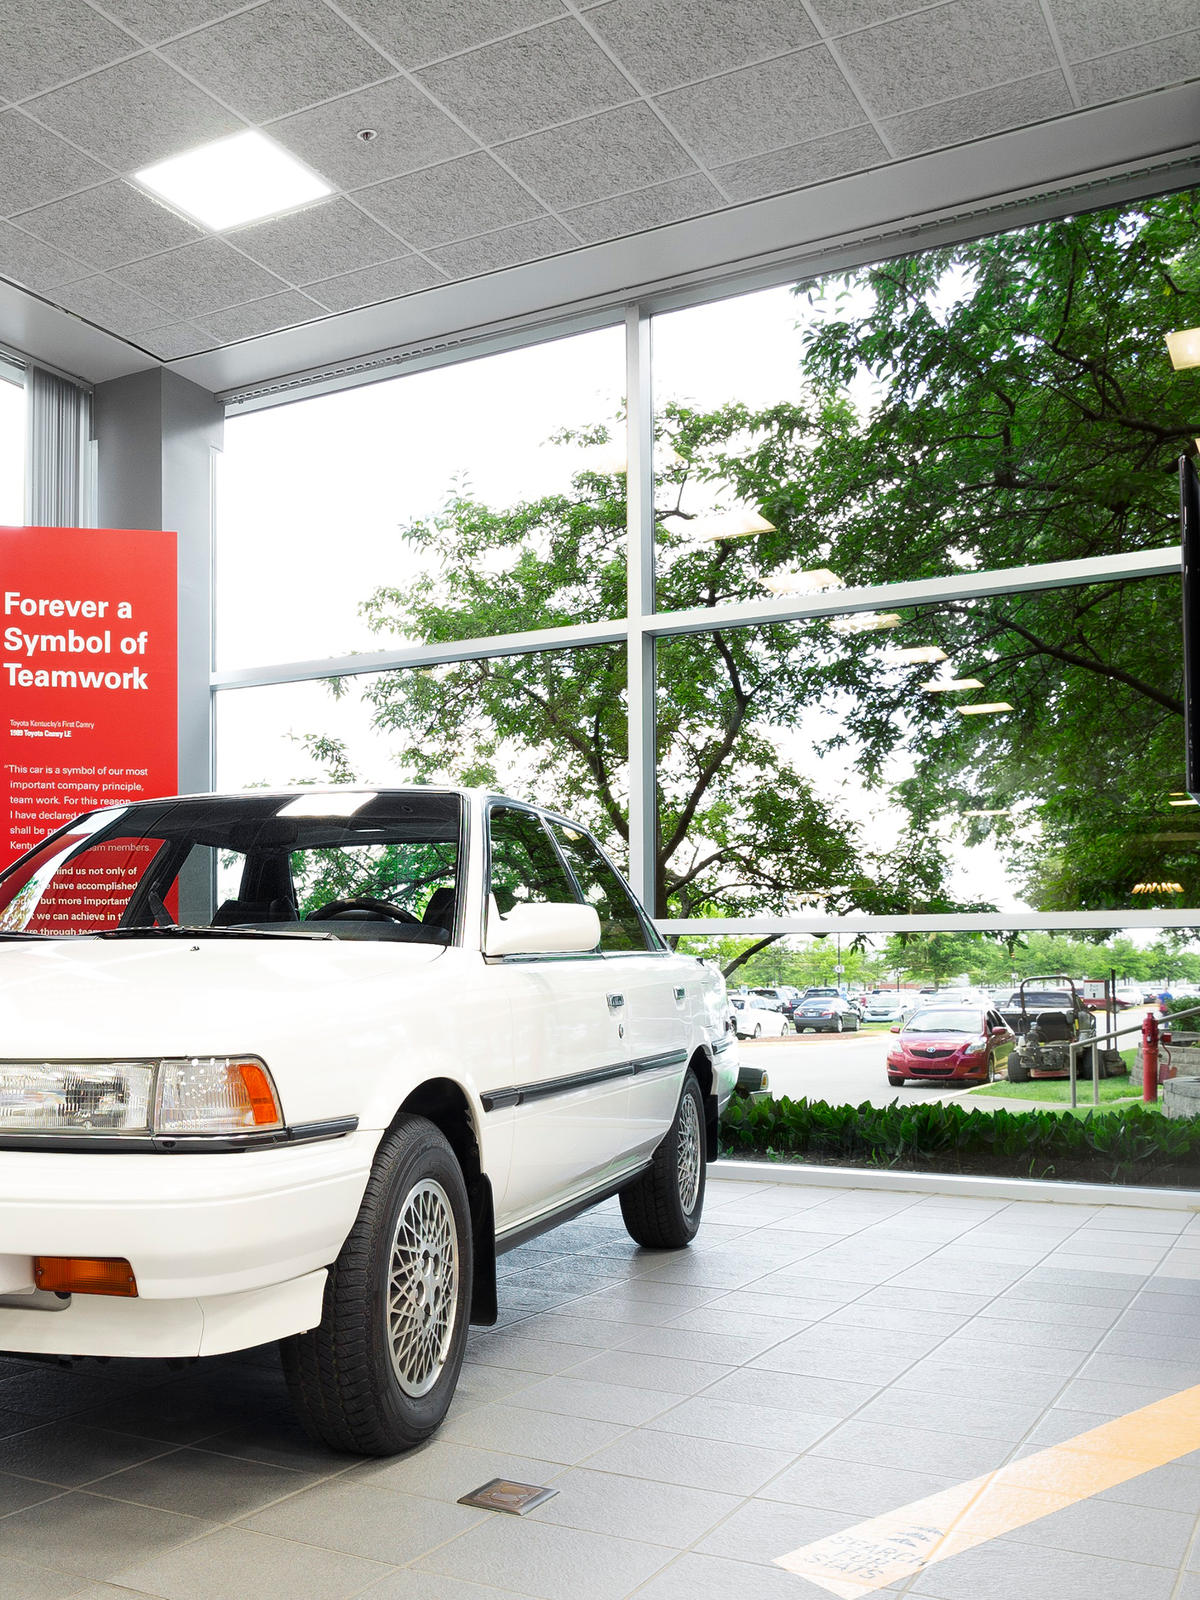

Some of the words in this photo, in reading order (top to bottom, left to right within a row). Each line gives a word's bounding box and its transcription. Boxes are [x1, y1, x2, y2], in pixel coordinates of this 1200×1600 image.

[4, 592, 109, 619] Forever
[117, 600, 132, 619] a
[4, 628, 111, 656] Symbol
[120, 631, 148, 655] of
[3, 662, 148, 690] Teamwork
[62, 766, 95, 776] symbol
[98, 767, 107, 775] of
[10, 781, 55, 790] important
[58, 783, 100, 792] company
[102, 782, 144, 792] principle,
[10, 796, 33, 804] team
[36, 796, 60, 804] work.
[81, 797, 98, 805] this
[10, 811, 12, 819] I
[15, 811, 36, 819] have
[39, 811, 75, 820] declared
[10, 826, 31, 834] shall
[34, 826, 45, 834] be
[88, 867, 103, 875] not
[105, 866, 126, 876] only
[128, 866, 138, 875] of
[53, 882, 74, 890] have
[40, 897, 56, 905] but
[71, 912, 105, 920] achieve
[107, 912, 115, 920] in
